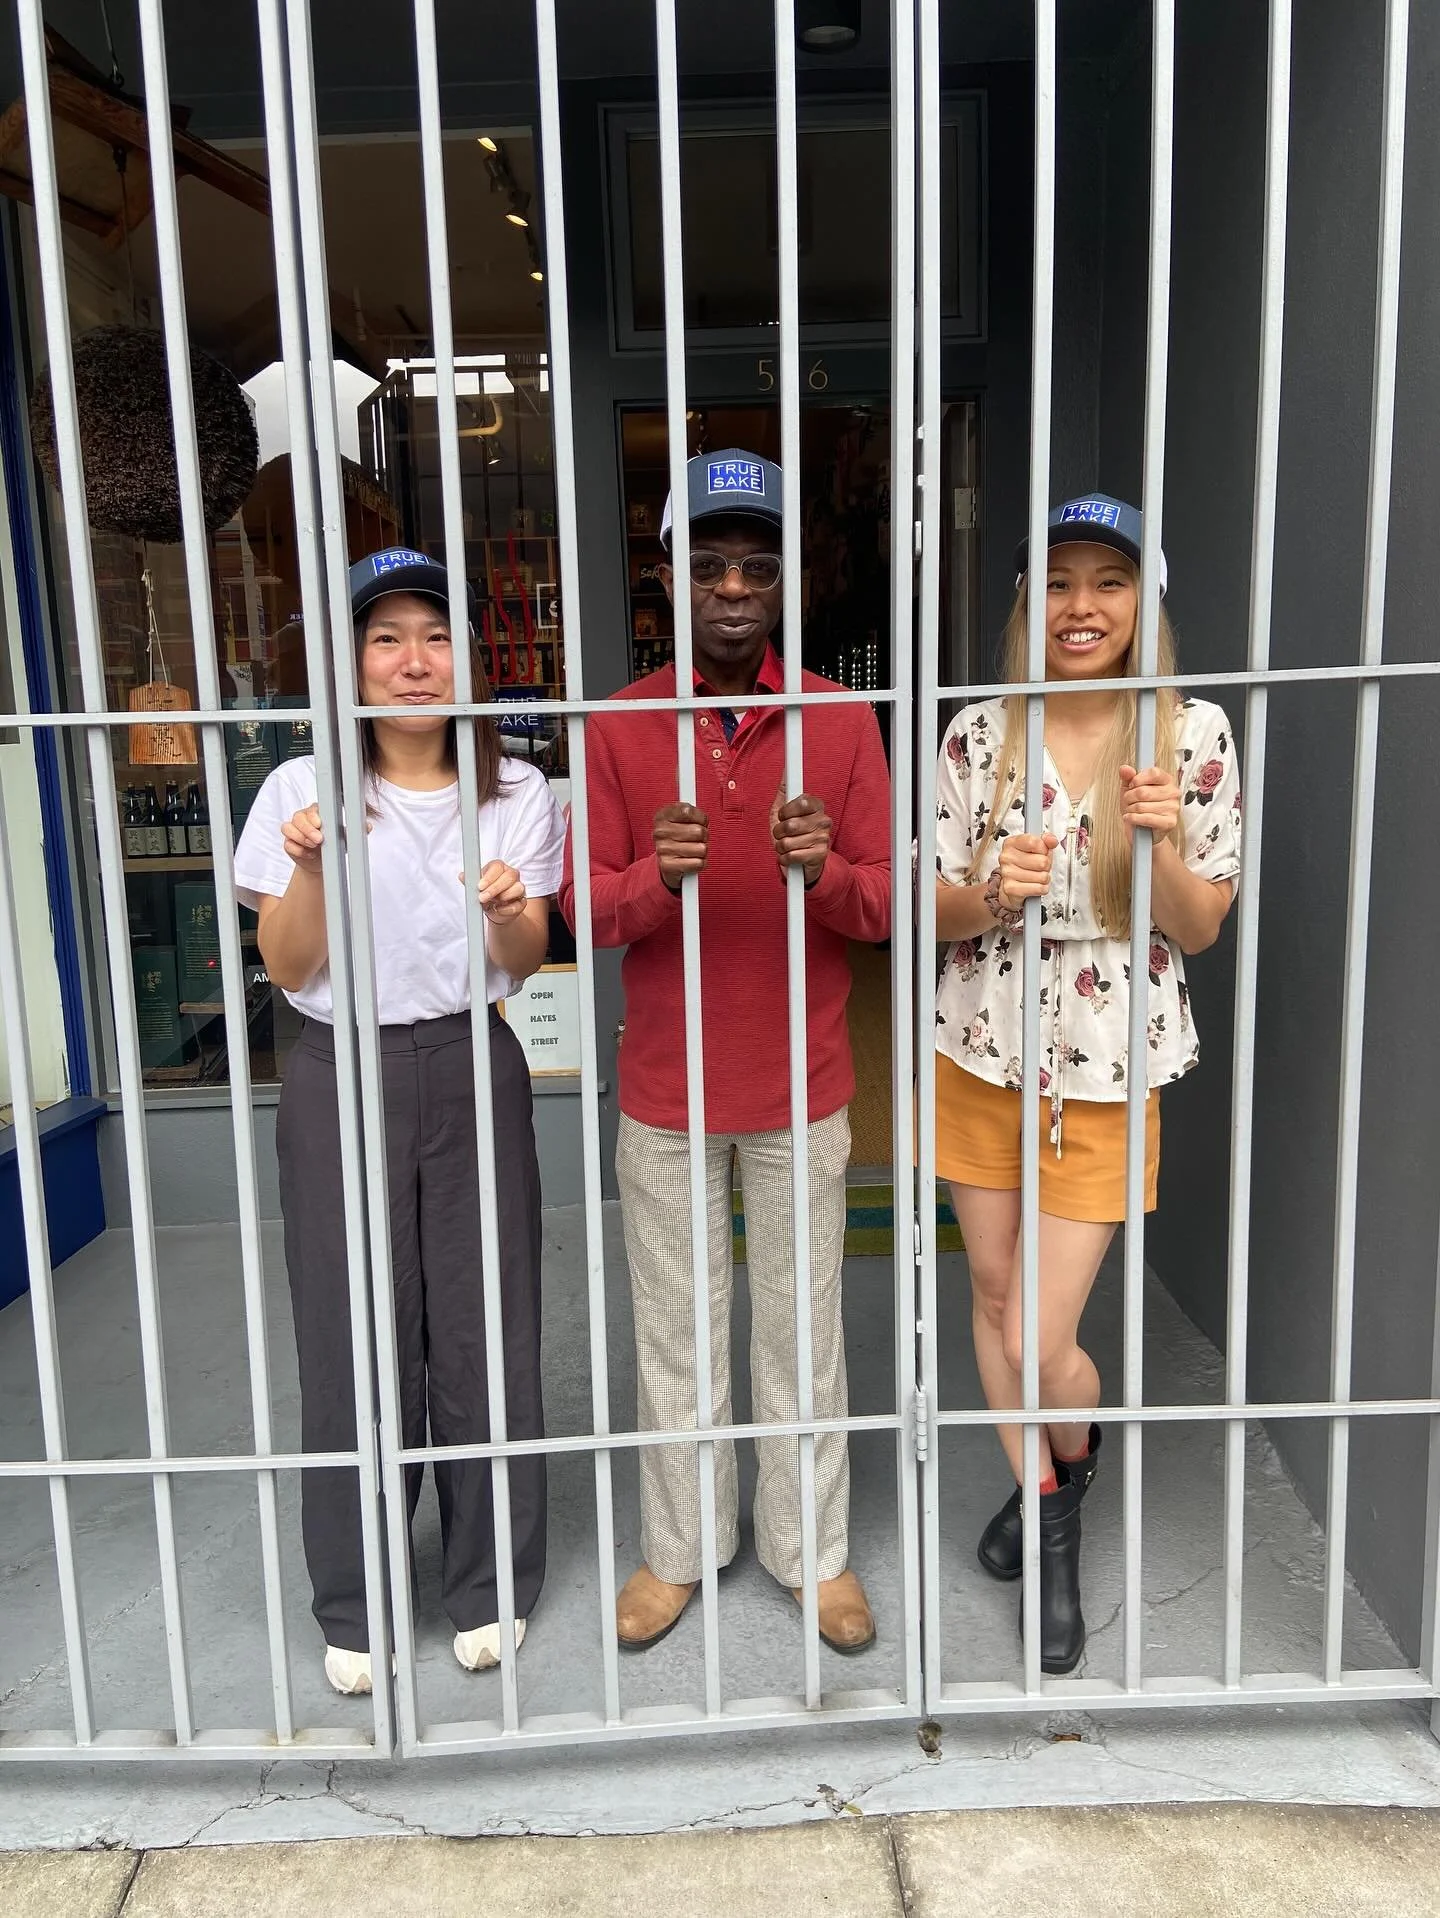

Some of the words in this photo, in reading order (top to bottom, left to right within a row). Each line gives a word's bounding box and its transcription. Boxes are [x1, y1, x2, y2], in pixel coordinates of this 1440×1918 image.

[758, 359, 828, 392] 56
[713, 463, 760, 477] TRUE
[713, 475, 761, 490] SAKE
[1067, 503, 1115, 516] TRUE
[377, 552, 426, 564] TRUE
[530, 991, 554, 1000] OPEN
[530, 1014, 557, 1023] HAYES
[530, 1037, 560, 1046] STREET
